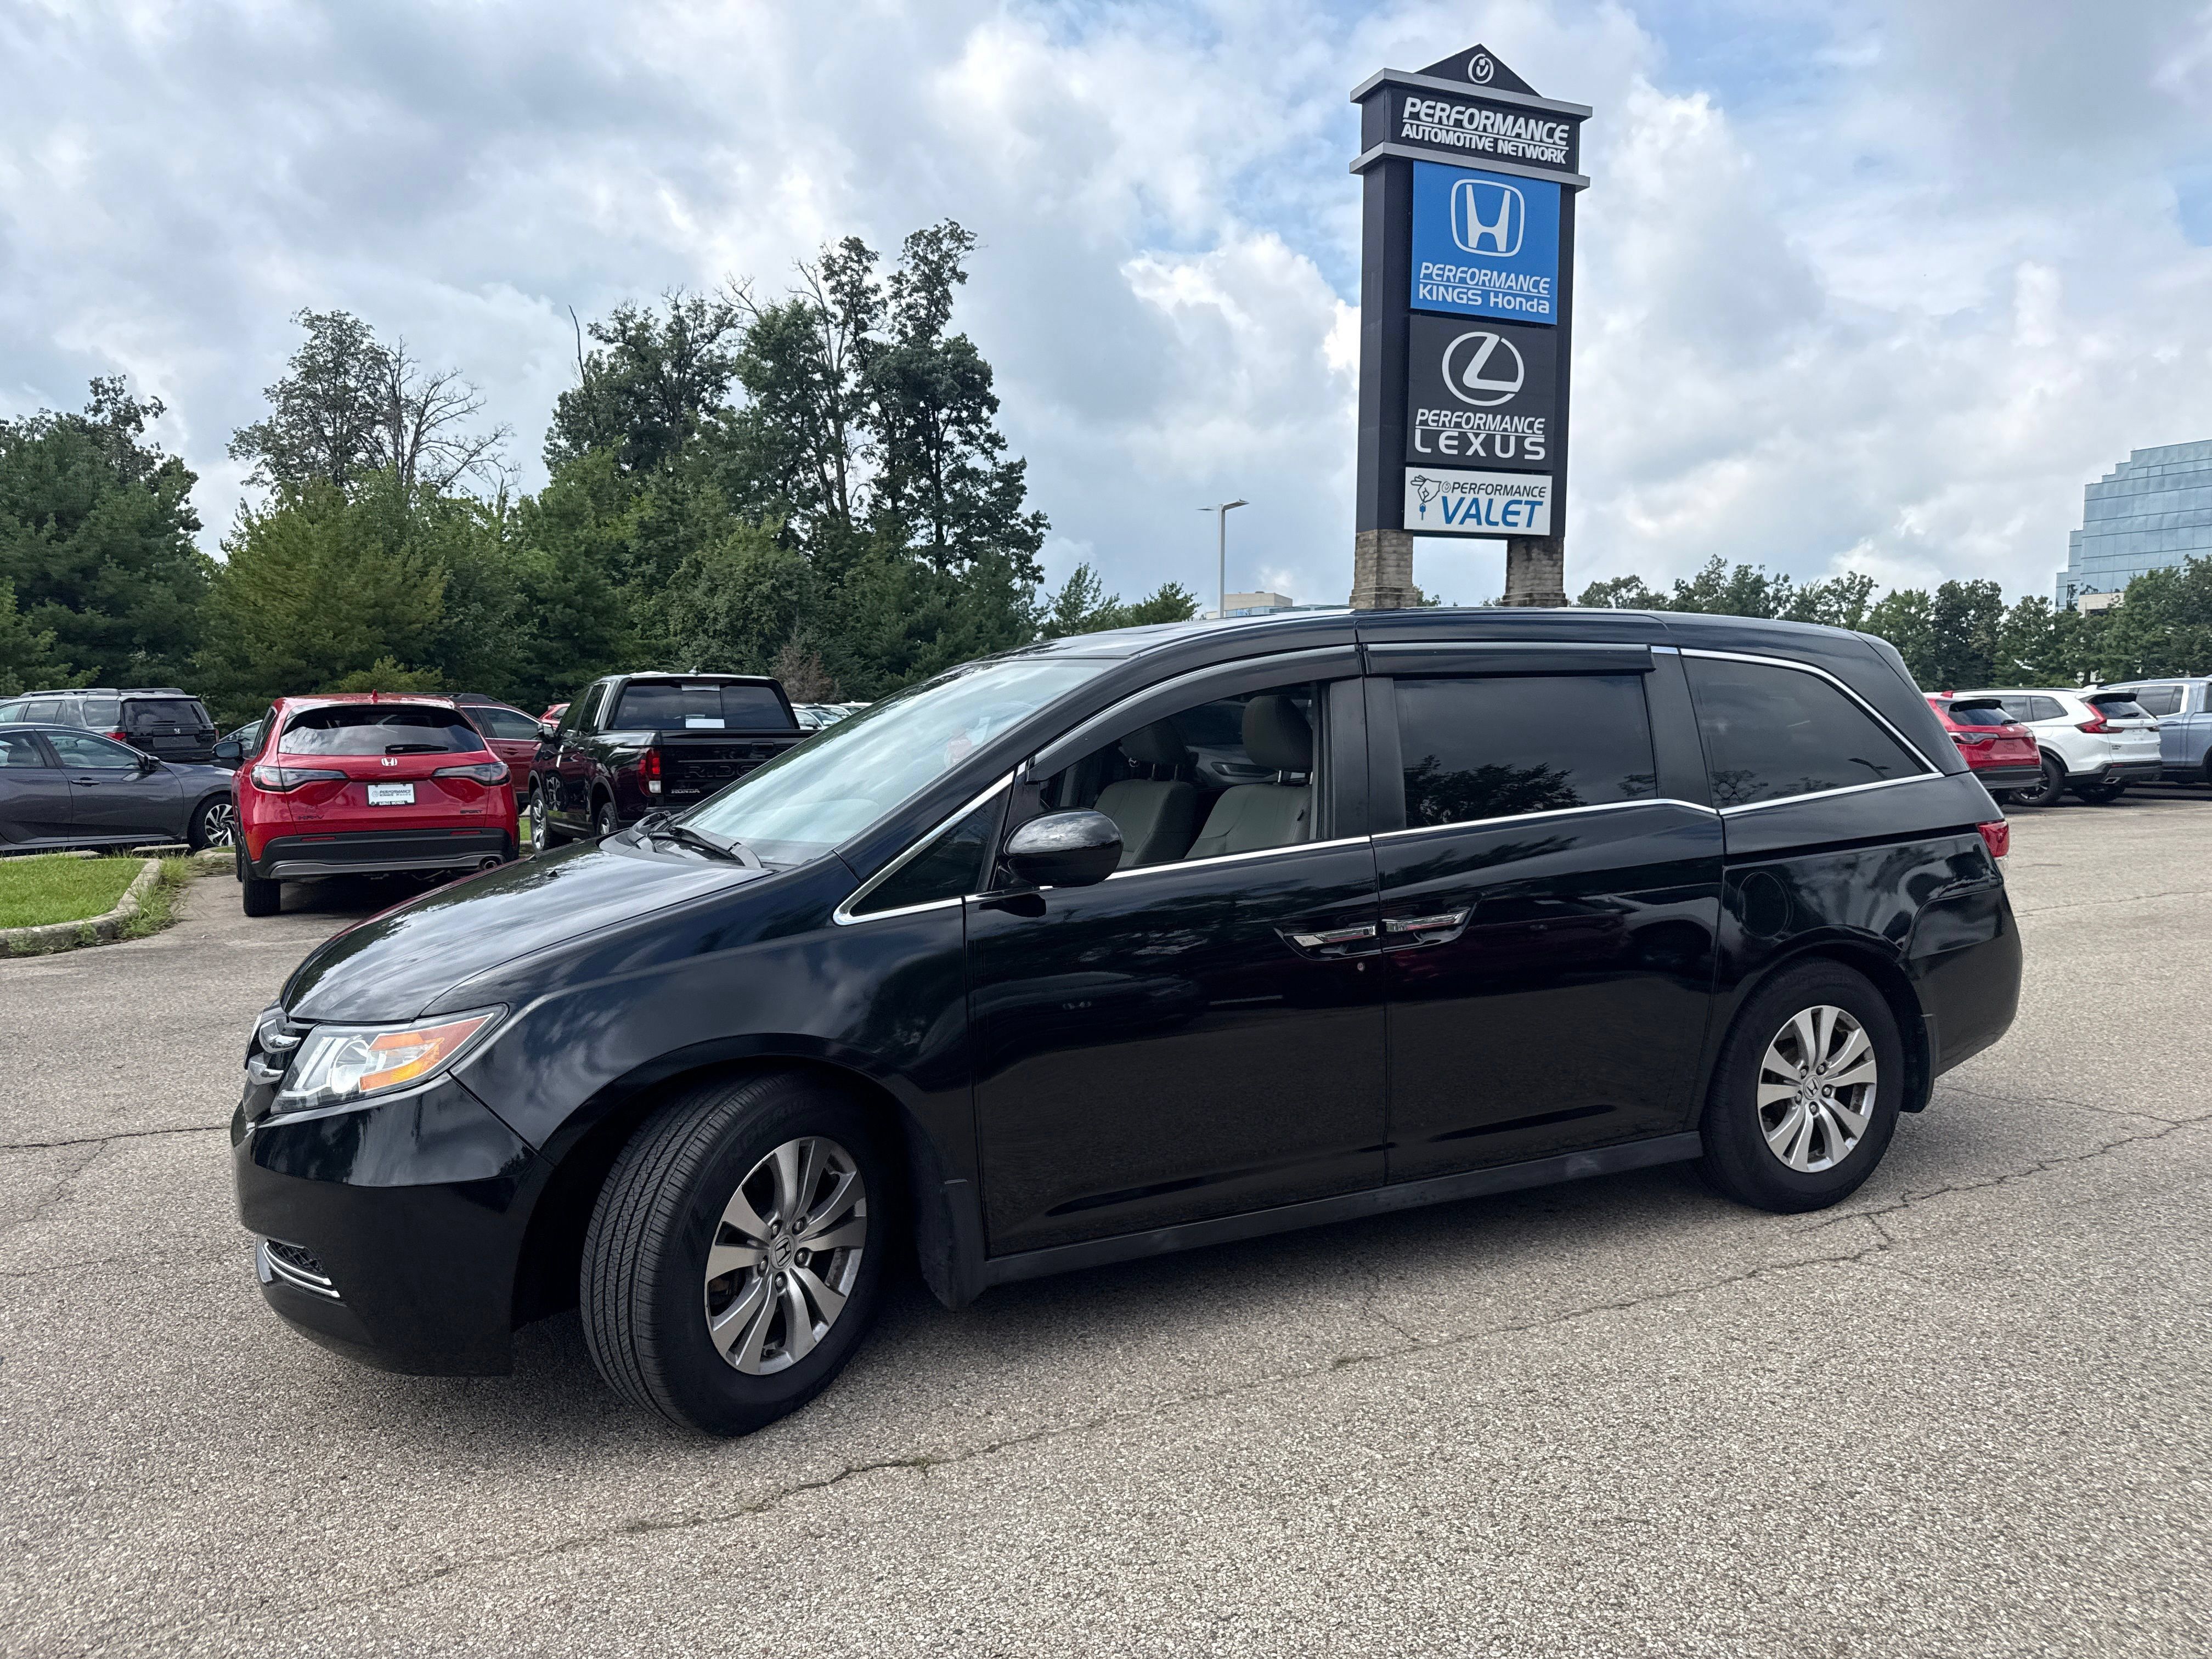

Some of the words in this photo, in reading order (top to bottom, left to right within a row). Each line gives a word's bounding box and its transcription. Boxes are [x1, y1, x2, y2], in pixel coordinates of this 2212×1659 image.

[1403, 97, 1570, 145] PERFORMANCE
[1401, 123, 1494, 152] AUTOMOTIVE
[1497, 139, 1567, 164] NETWORK
[1420, 262, 1551, 294] PERFORMANCE
[1419, 284, 1482, 306] KINGS
[1489, 292, 1550, 314] Honda
[1415, 408, 1545, 435] PERFORMANCE
[1414, 429, 1545, 460] LEXUS
[1451, 482, 1547, 498] PERFORMANCE
[1442, 496, 1544, 528] VALET
